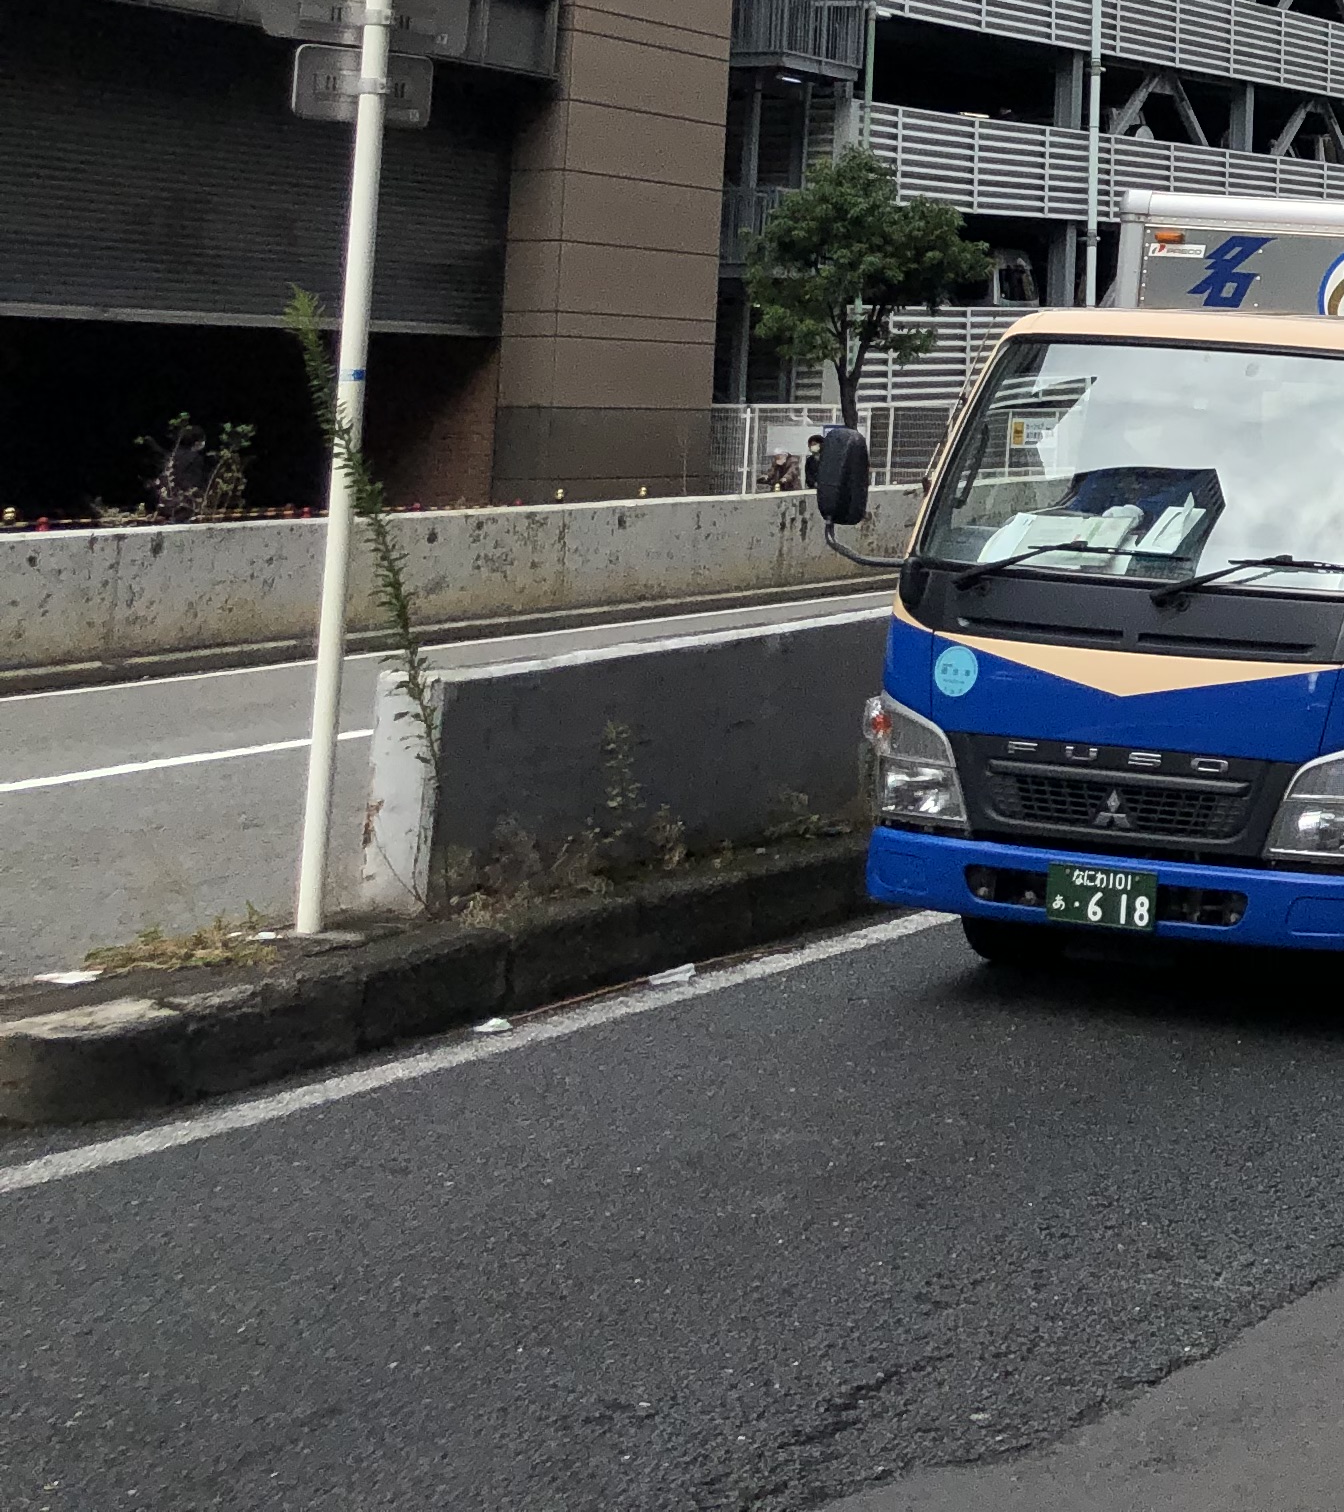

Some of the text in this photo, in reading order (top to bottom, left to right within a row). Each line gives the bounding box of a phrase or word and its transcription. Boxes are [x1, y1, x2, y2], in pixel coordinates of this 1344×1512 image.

[1188, 235, 1278, 309] 名
[1007, 740, 1229, 774] FUSO
[1052, 893, 1066, 910] あ
